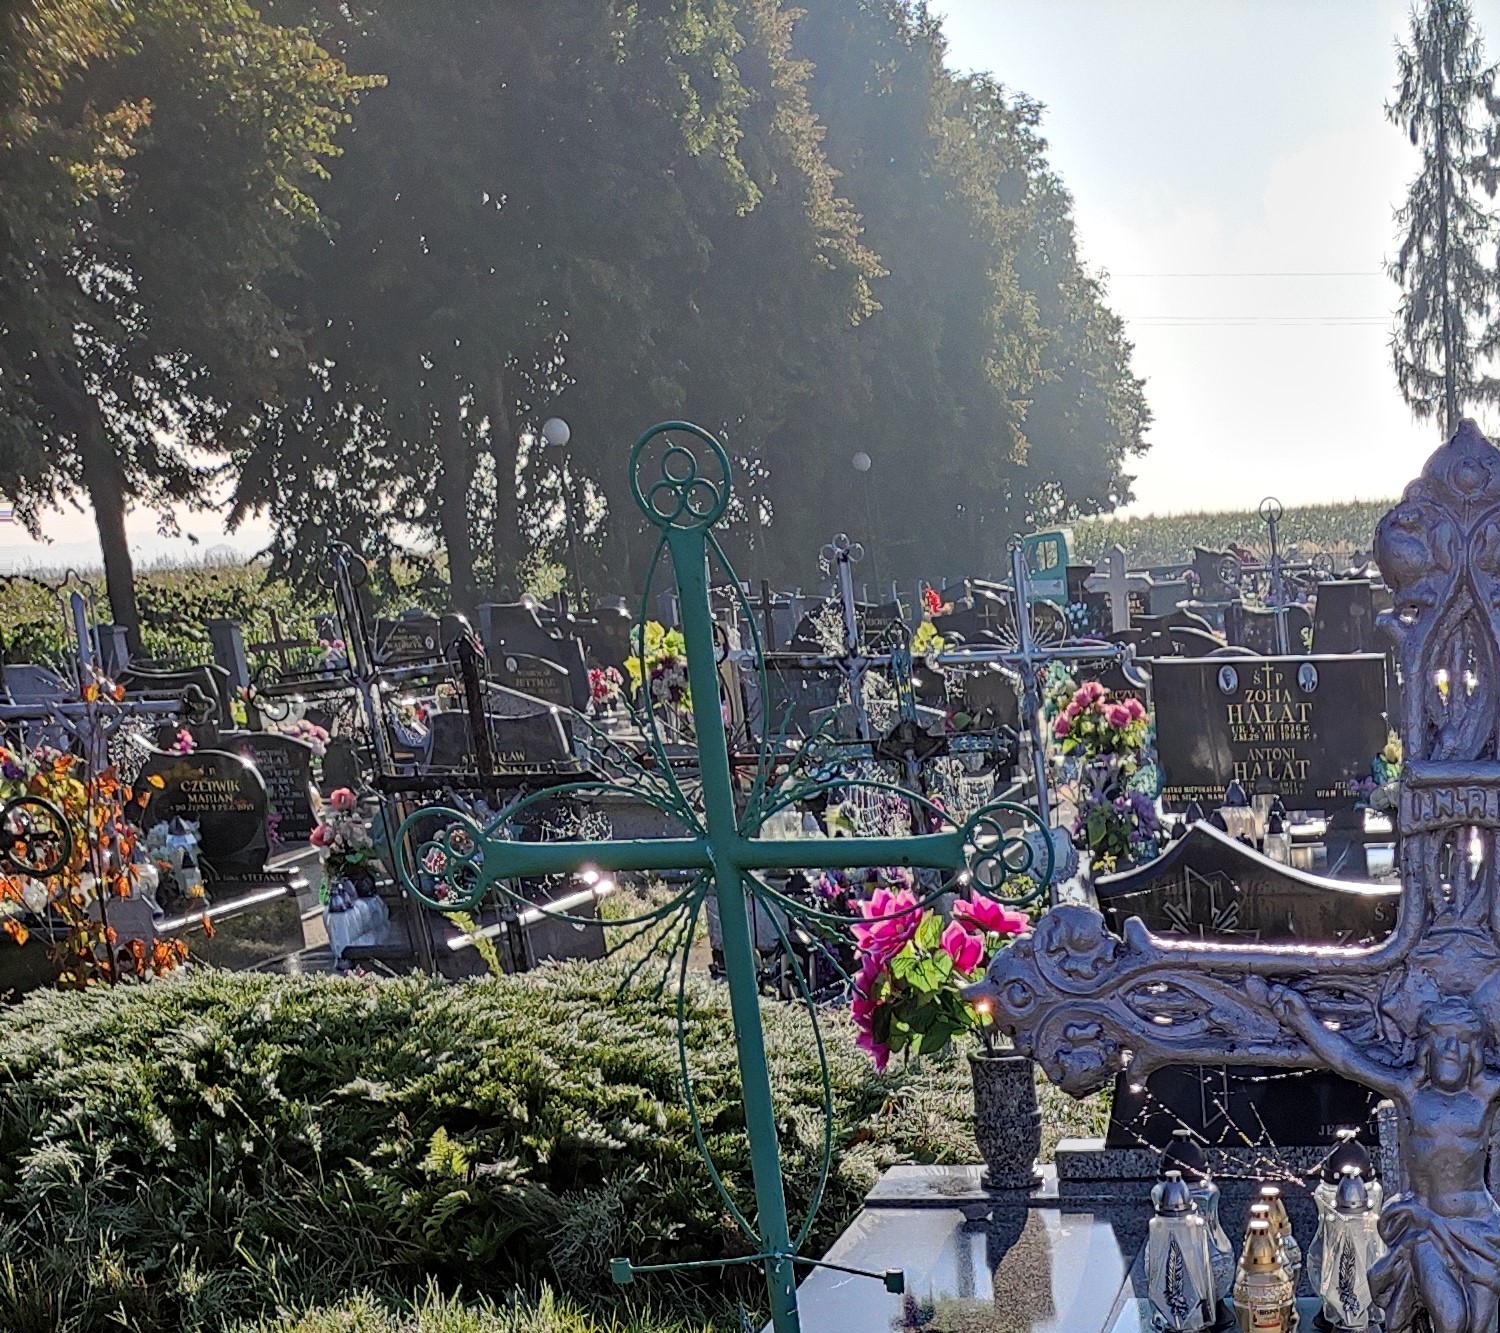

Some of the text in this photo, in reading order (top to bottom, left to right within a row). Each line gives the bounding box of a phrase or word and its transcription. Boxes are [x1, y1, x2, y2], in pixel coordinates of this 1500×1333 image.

[1245, 689, 1291, 703] ZOFIA
[1227, 702, 1313, 724] HAŁAT
[1247, 747, 1295, 760] ANTONI
[180, 779, 241, 793] CZERWIK
[187, 793, 233, 803] MARIAN
